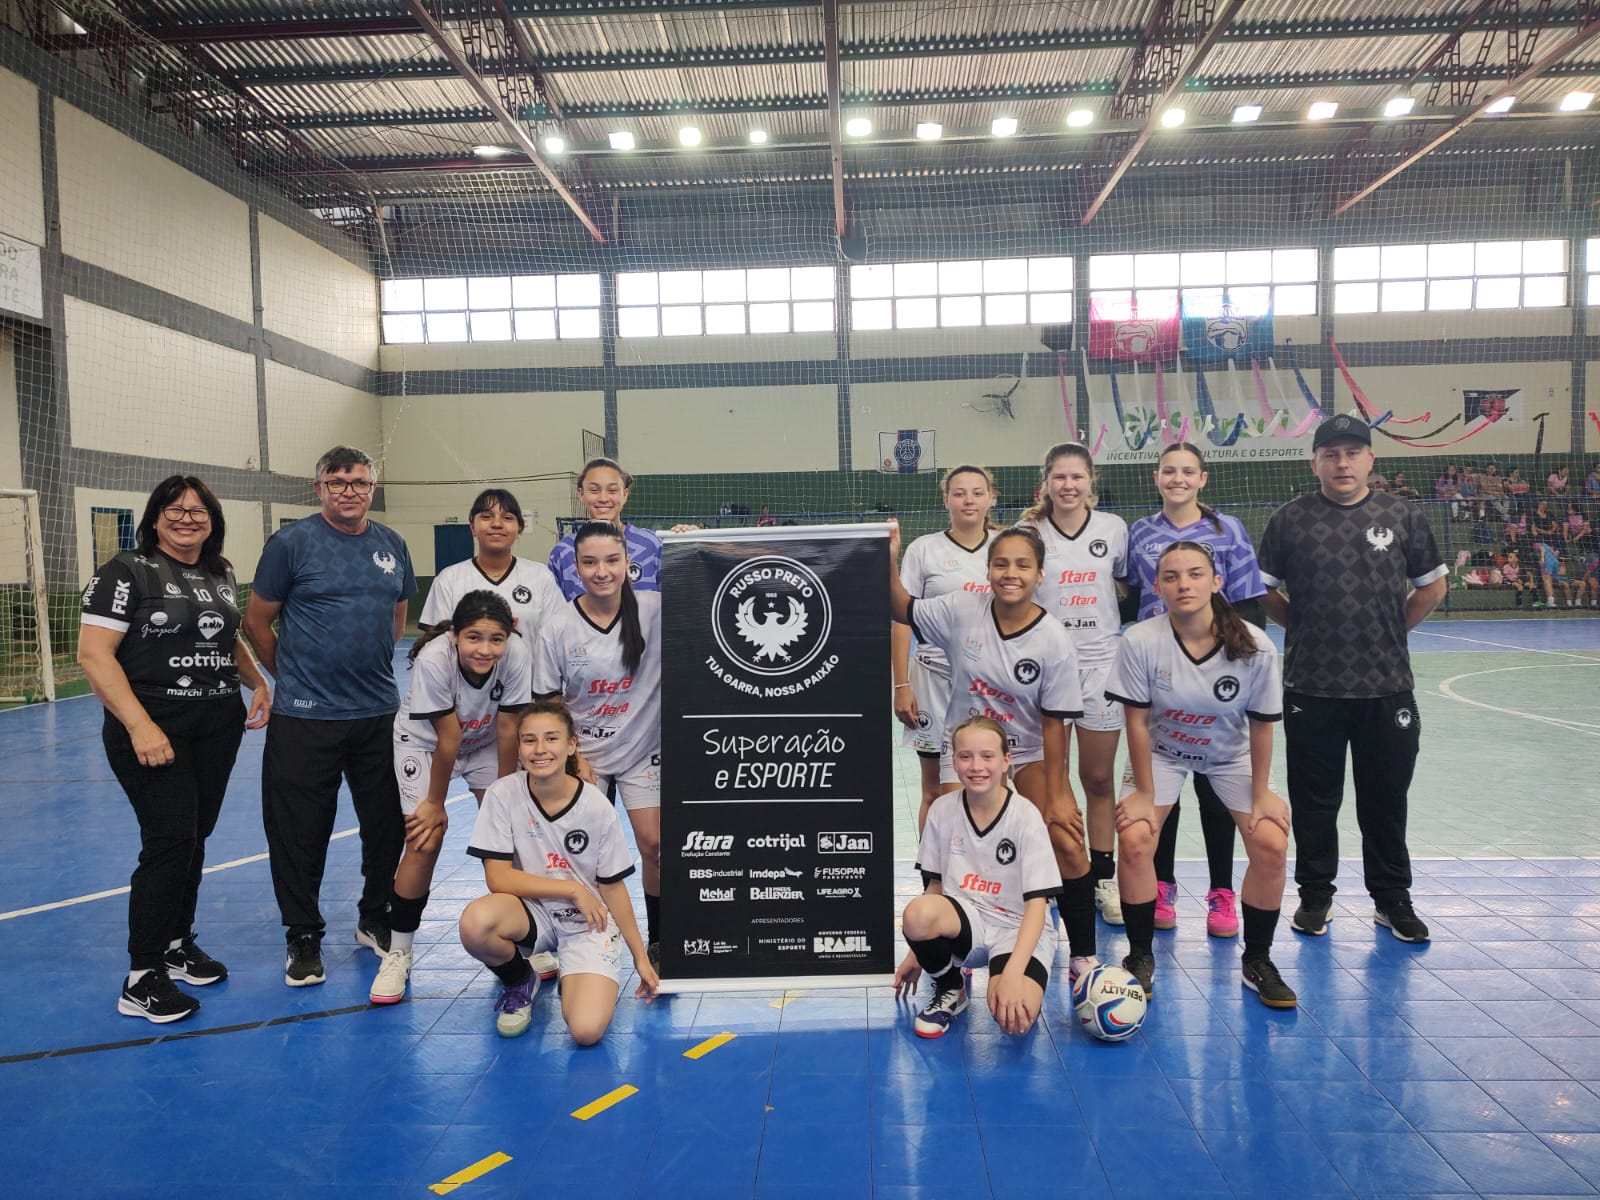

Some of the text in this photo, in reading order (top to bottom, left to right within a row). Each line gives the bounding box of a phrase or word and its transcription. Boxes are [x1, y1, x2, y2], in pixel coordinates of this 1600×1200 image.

[1106, 451, 1160, 461] INCENTIVA
[1201, 448, 1305, 459] ULTURA E O ESPORTE
[729, 568, 814, 598] RUSSO PRETO
[1058, 569, 1097, 585] Stara
[111, 578, 131, 616] FISK
[192, 588, 213, 602] 10
[1069, 595, 1098, 607] Stara
[1074, 619, 1097, 628] Jan
[705, 654, 840, 698] TUA GARRA, NOSSA PAIXÃO
[166, 688, 203, 697] marchi
[703, 728, 845, 760] Superação
[1169, 731, 1212, 746] Stara
[1172, 751, 1204, 761] Jan
[714, 762, 837, 789] e ESPORTE
[682, 831, 735, 851] Stara
[747, 834, 806, 851] cotrijal
[836, 834, 870, 850] Jan
[749, 868, 786, 880] Imdepa
[822, 867, 866, 875] FUSOPAR
[959, 873, 1002, 895] Stara
[813, 936, 872, 953] BRASIL
[1101, 985, 1143, 1002] PENALTY
